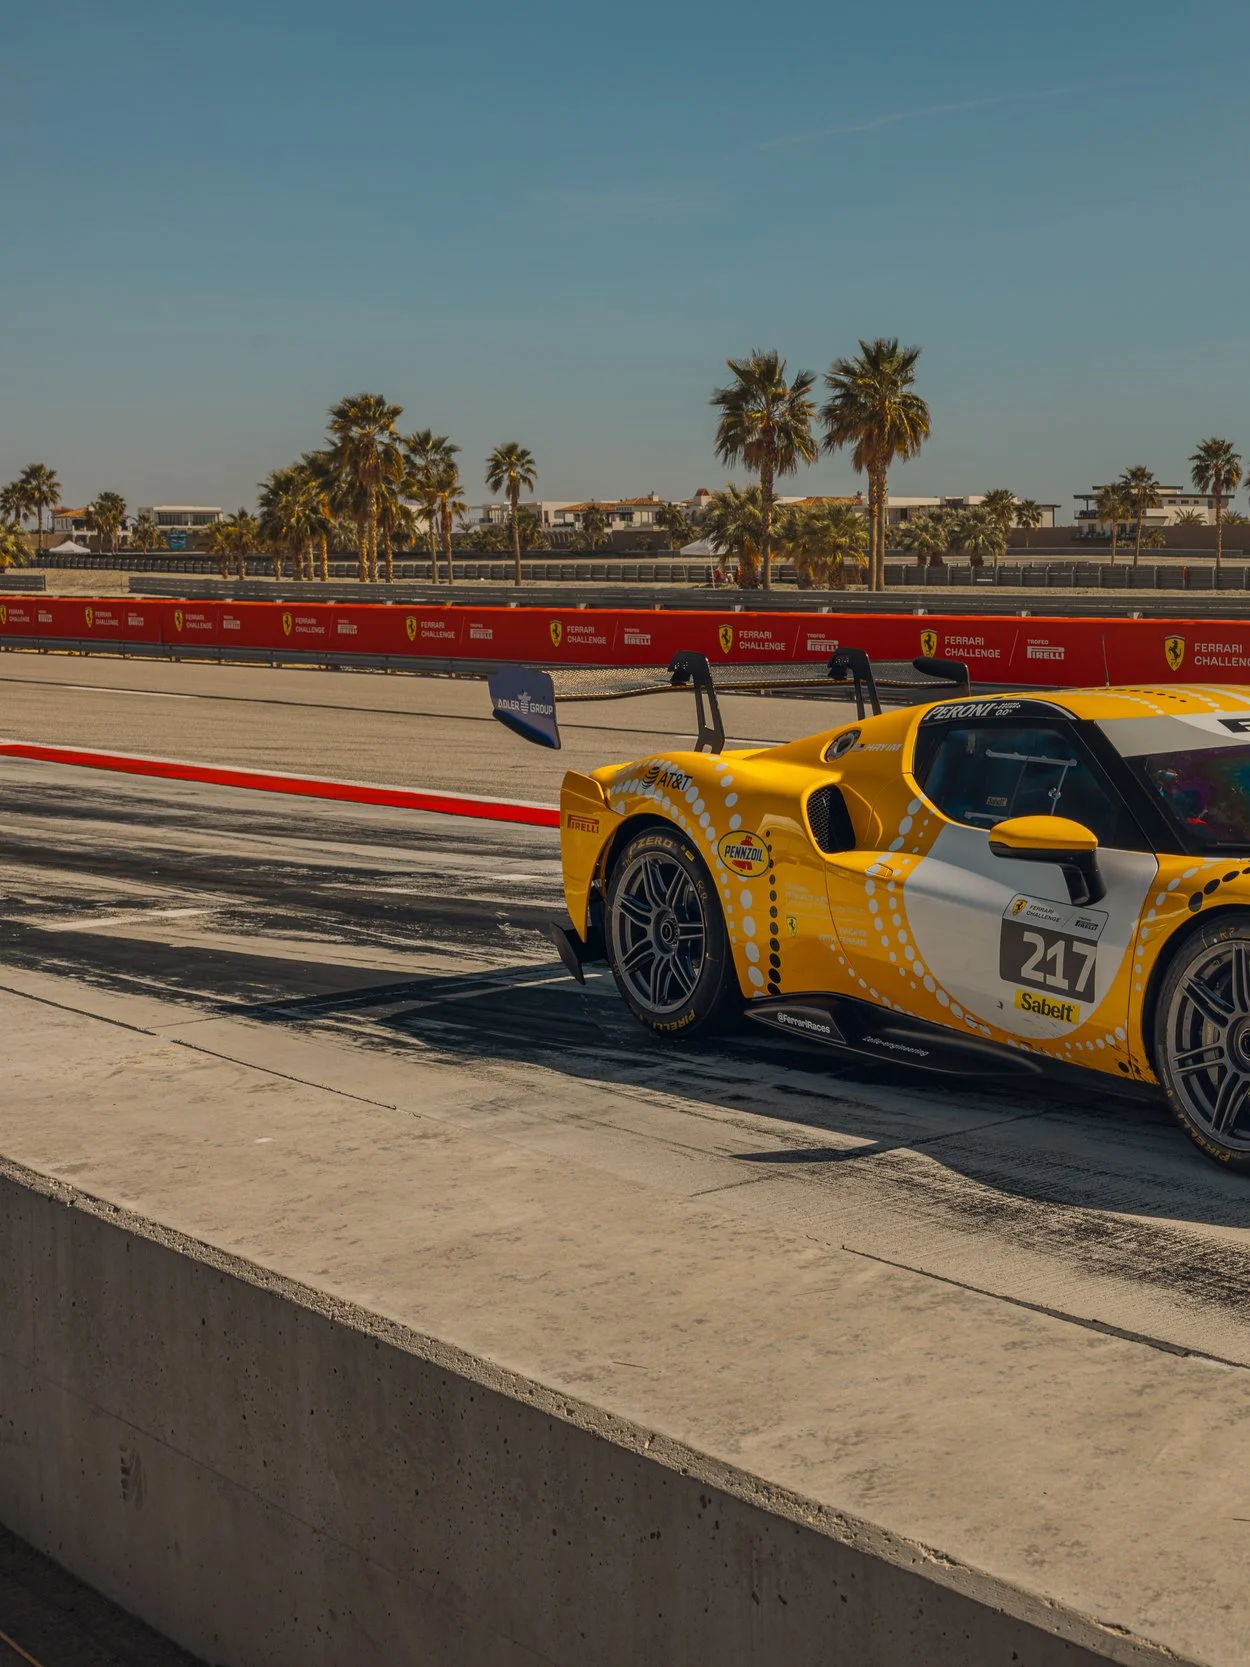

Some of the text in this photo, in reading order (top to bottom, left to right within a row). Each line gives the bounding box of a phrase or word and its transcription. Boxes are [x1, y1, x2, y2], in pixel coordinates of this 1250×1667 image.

[295, 617, 317, 625] FERRARI
[421, 621, 445, 629] FERRARI
[295, 626, 325, 634] CHALLENGE
[421, 630, 455, 639] CHALLENGE
[567, 625, 595, 634] FERRARI
[739, 630, 772, 639] FERRARI
[567, 635, 607, 645] CHALLENGE
[624, 633, 651, 645] PIRELLI
[944, 636, 985, 646] FERRARI
[739, 641, 786, 651] CHALLENGE
[1194, 643, 1243, 654] FERRARI
[944, 648, 1001, 659] CHALLENGE
[1027, 646, 1065, 660] PIRELLI
[498, 698, 553, 715] ADLER GROUP
[923, 703, 995, 720] PERONI
[656, 771, 693, 791] AT&T
[567, 814, 600, 834] PIRELLI
[724, 845, 764, 862] PENNZOIL
[1029, 904, 1055, 915] FERRARI
[1026, 910, 1062, 923] CHALLENGE
[1020, 931, 1097, 993] 217
[1020, 992, 1074, 1023] Sabelt
[653, 1008, 696, 1032] PIRELLI
[777, 1012, 831, 1034] @FerrariRaces
